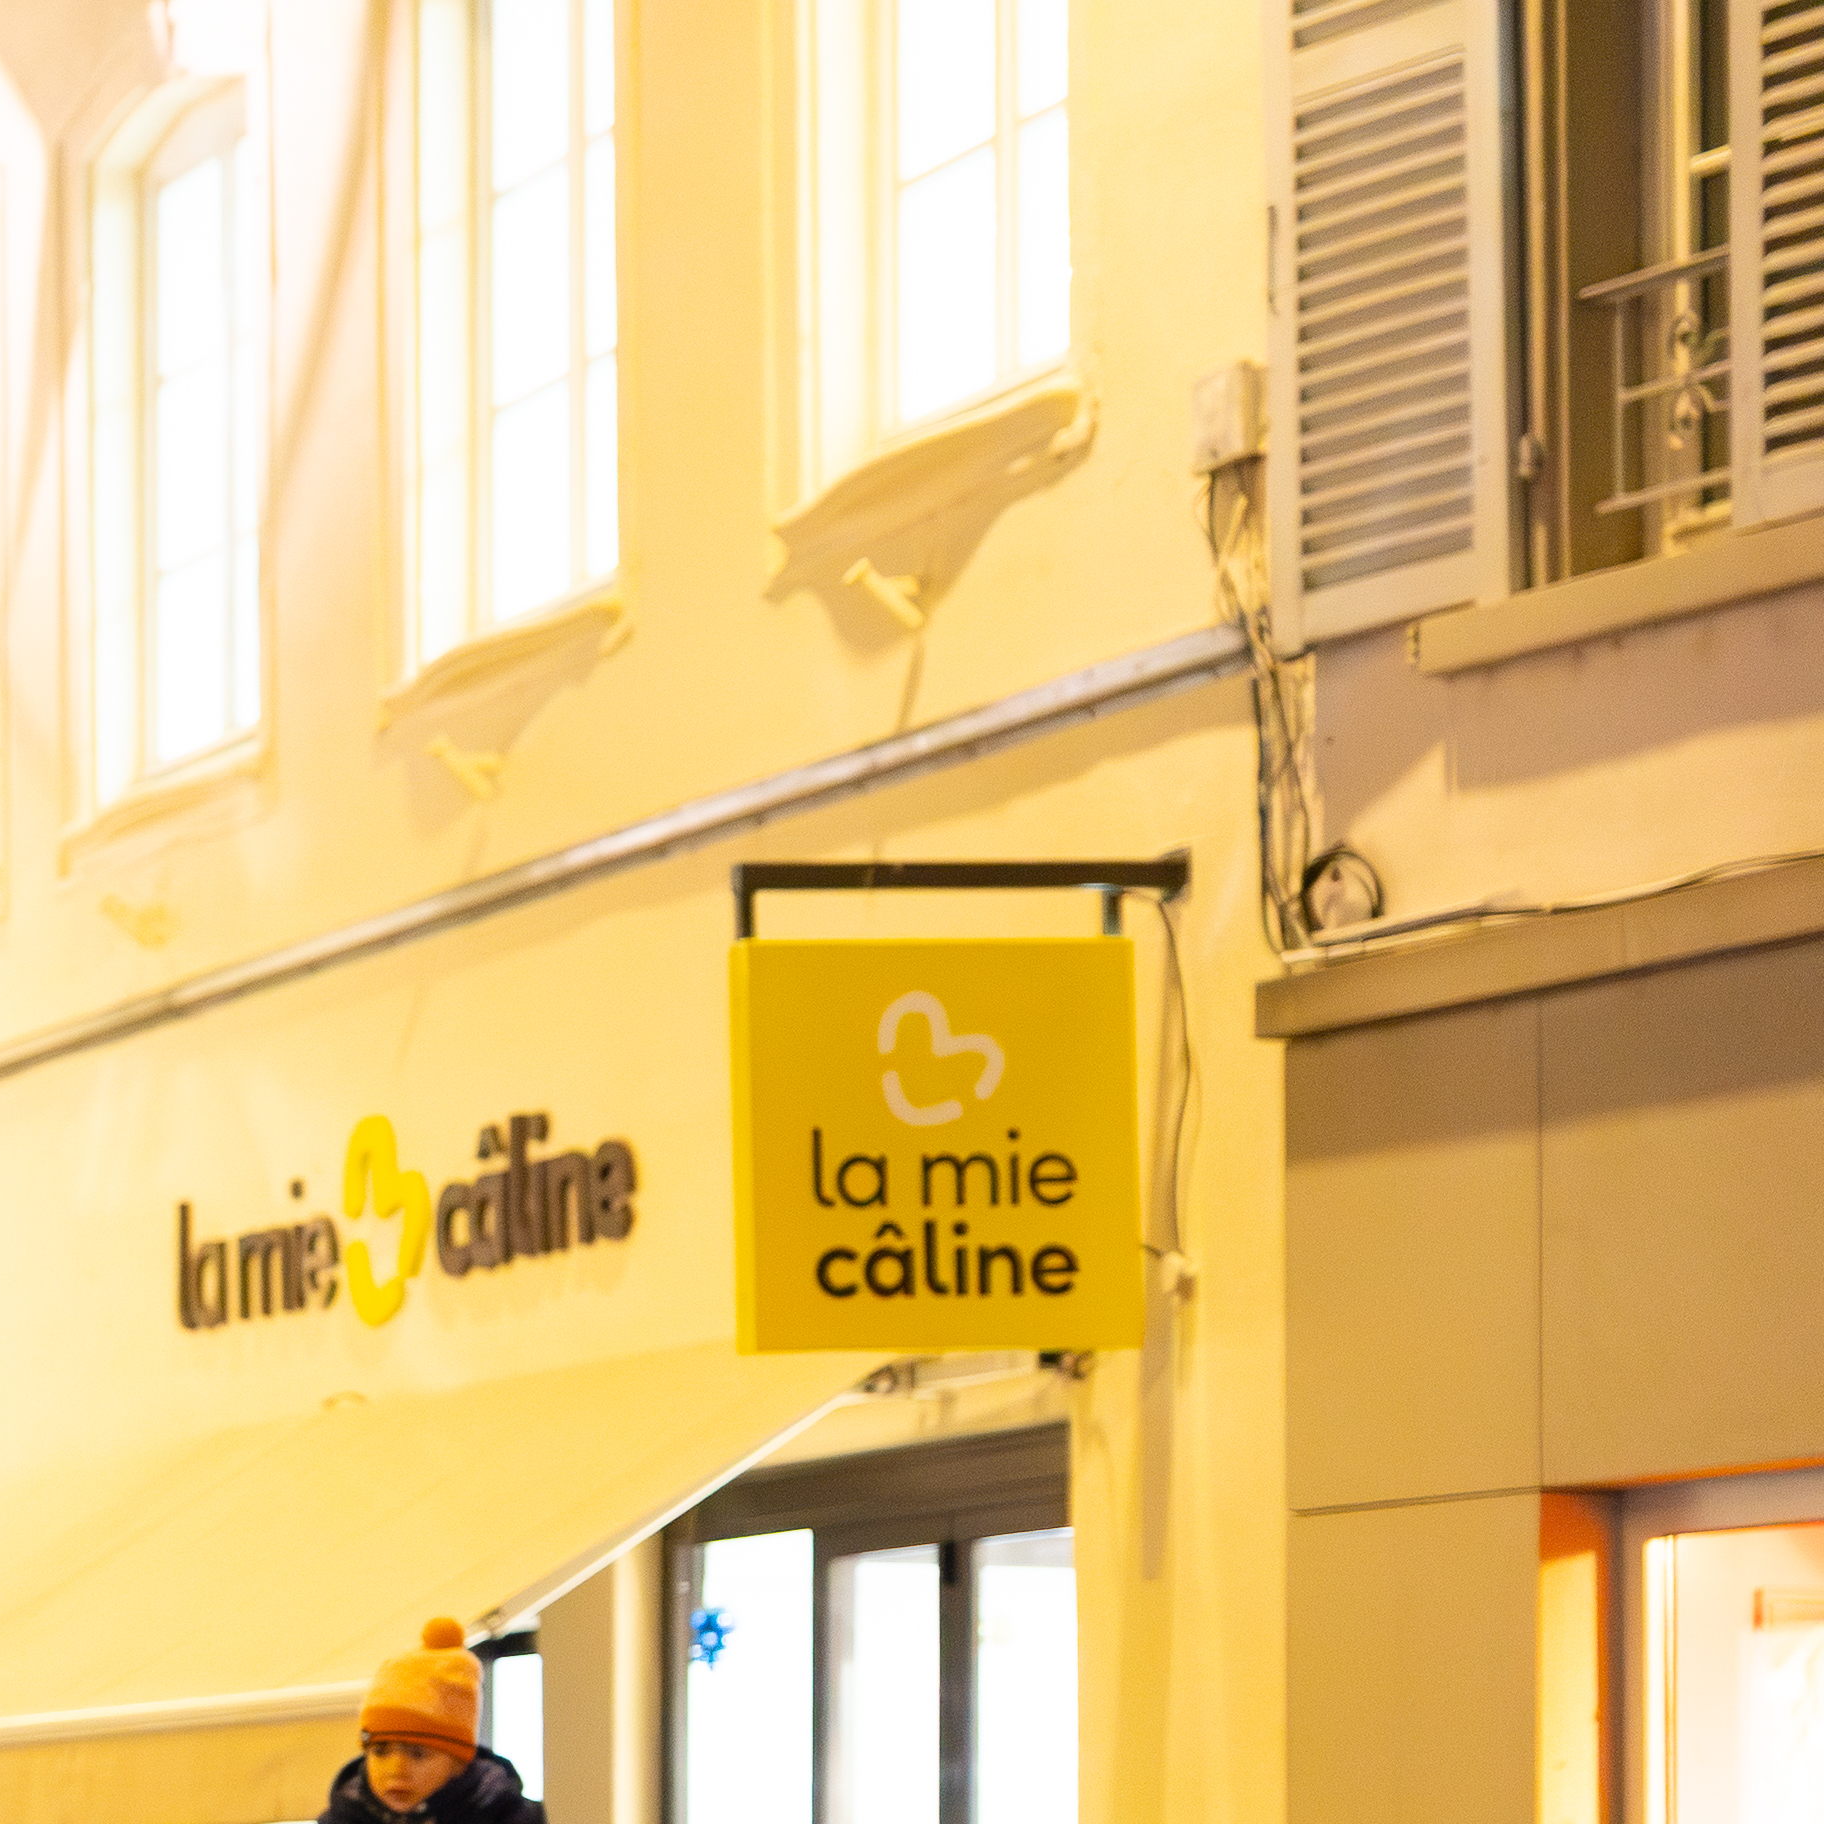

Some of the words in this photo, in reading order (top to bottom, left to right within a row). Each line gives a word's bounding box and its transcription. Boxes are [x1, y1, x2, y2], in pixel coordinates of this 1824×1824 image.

[811, 1127, 887, 1207] la
[921, 1128, 1078, 1207] mie
[177, 1201, 229, 1329] la
[238, 1178, 340, 1320] mie
[435, 1111, 637, 1278] câline
[815, 1219, 1080, 1298] câline
